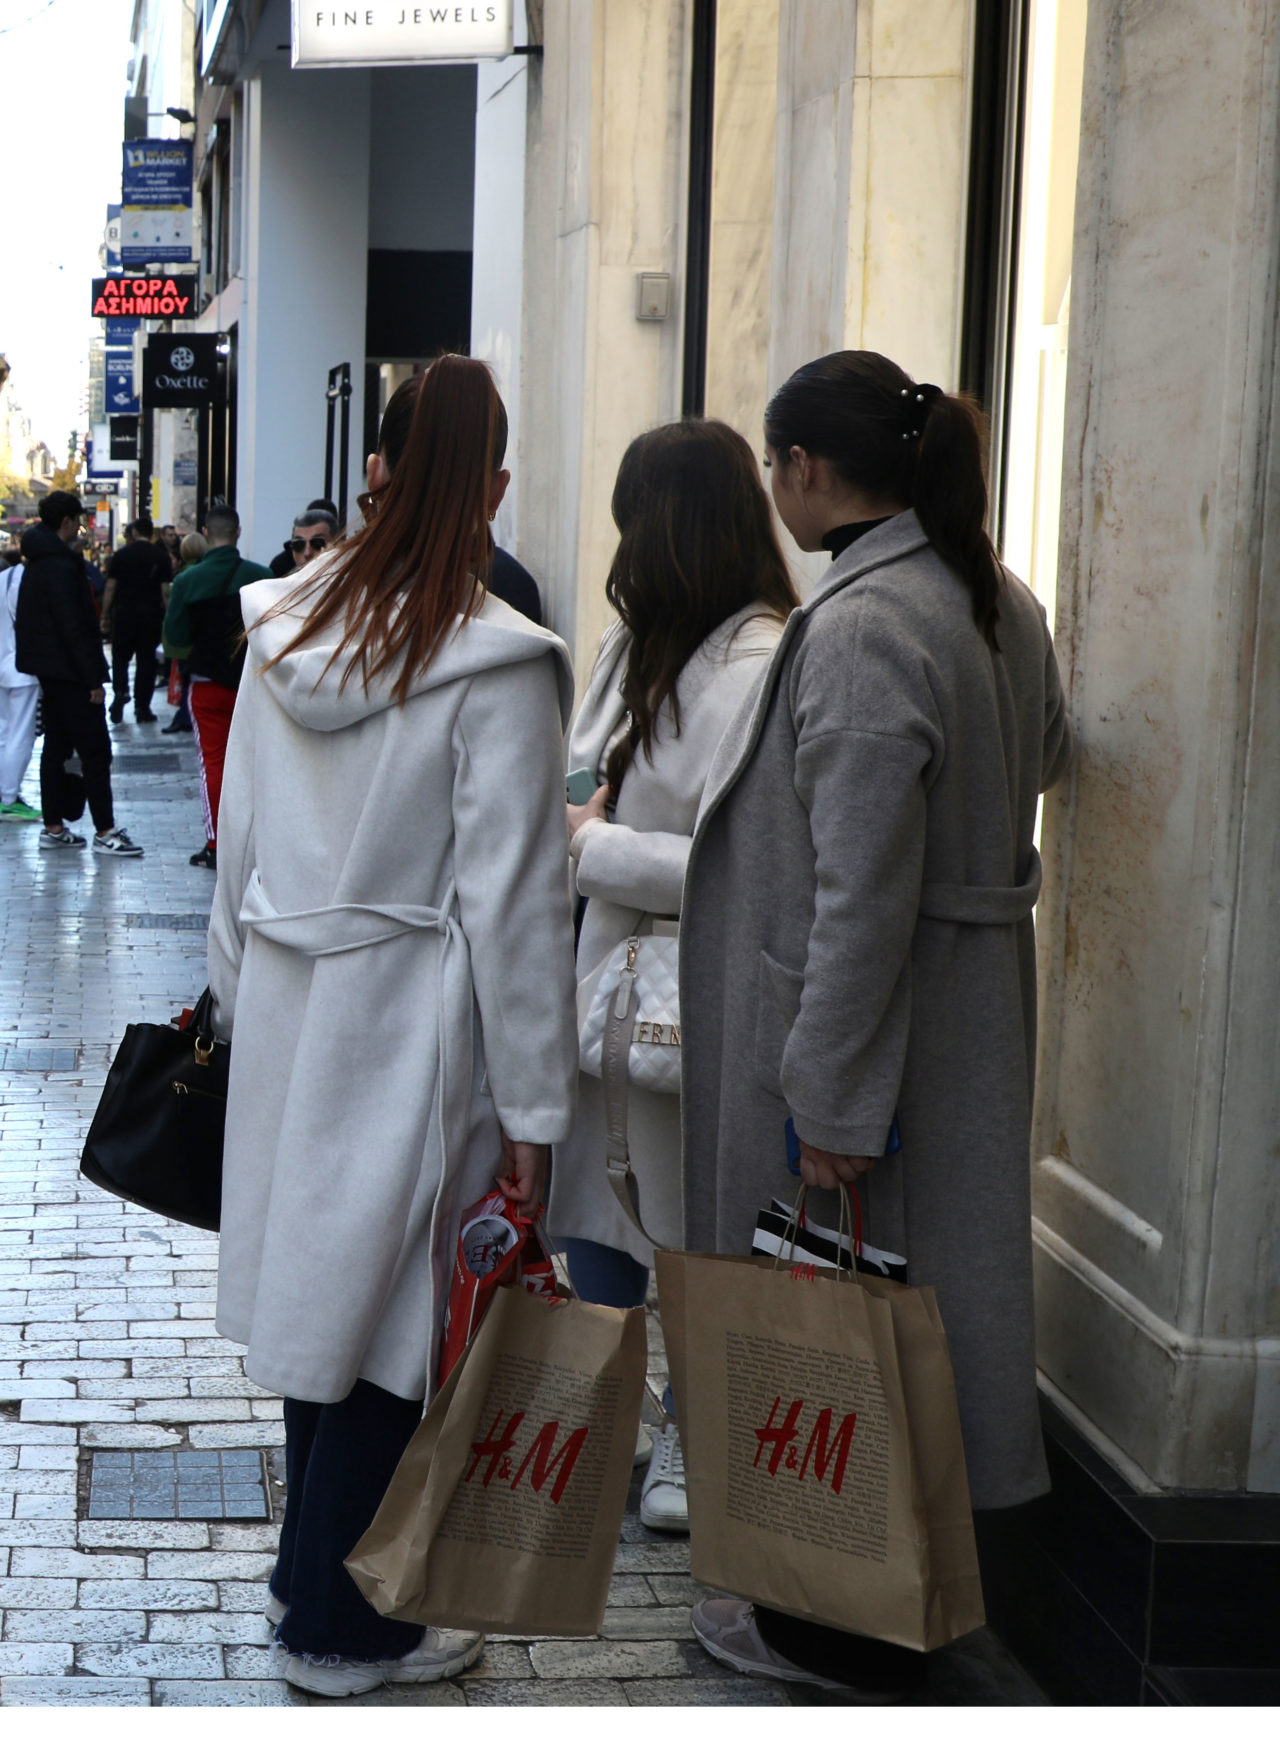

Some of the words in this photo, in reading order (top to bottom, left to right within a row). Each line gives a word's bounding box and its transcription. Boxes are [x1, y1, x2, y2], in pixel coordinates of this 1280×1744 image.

[317, 11, 373, 27] FINE
[398, 7, 496, 24] JEWELS
[103, 279, 178, 296] ΑΓΟΡΑ
[93, 297, 189, 315] ΑΣΗΜΙΟΥ
[753, 1395, 857, 1496] H&M
[464, 1408, 589, 1505] H&M
